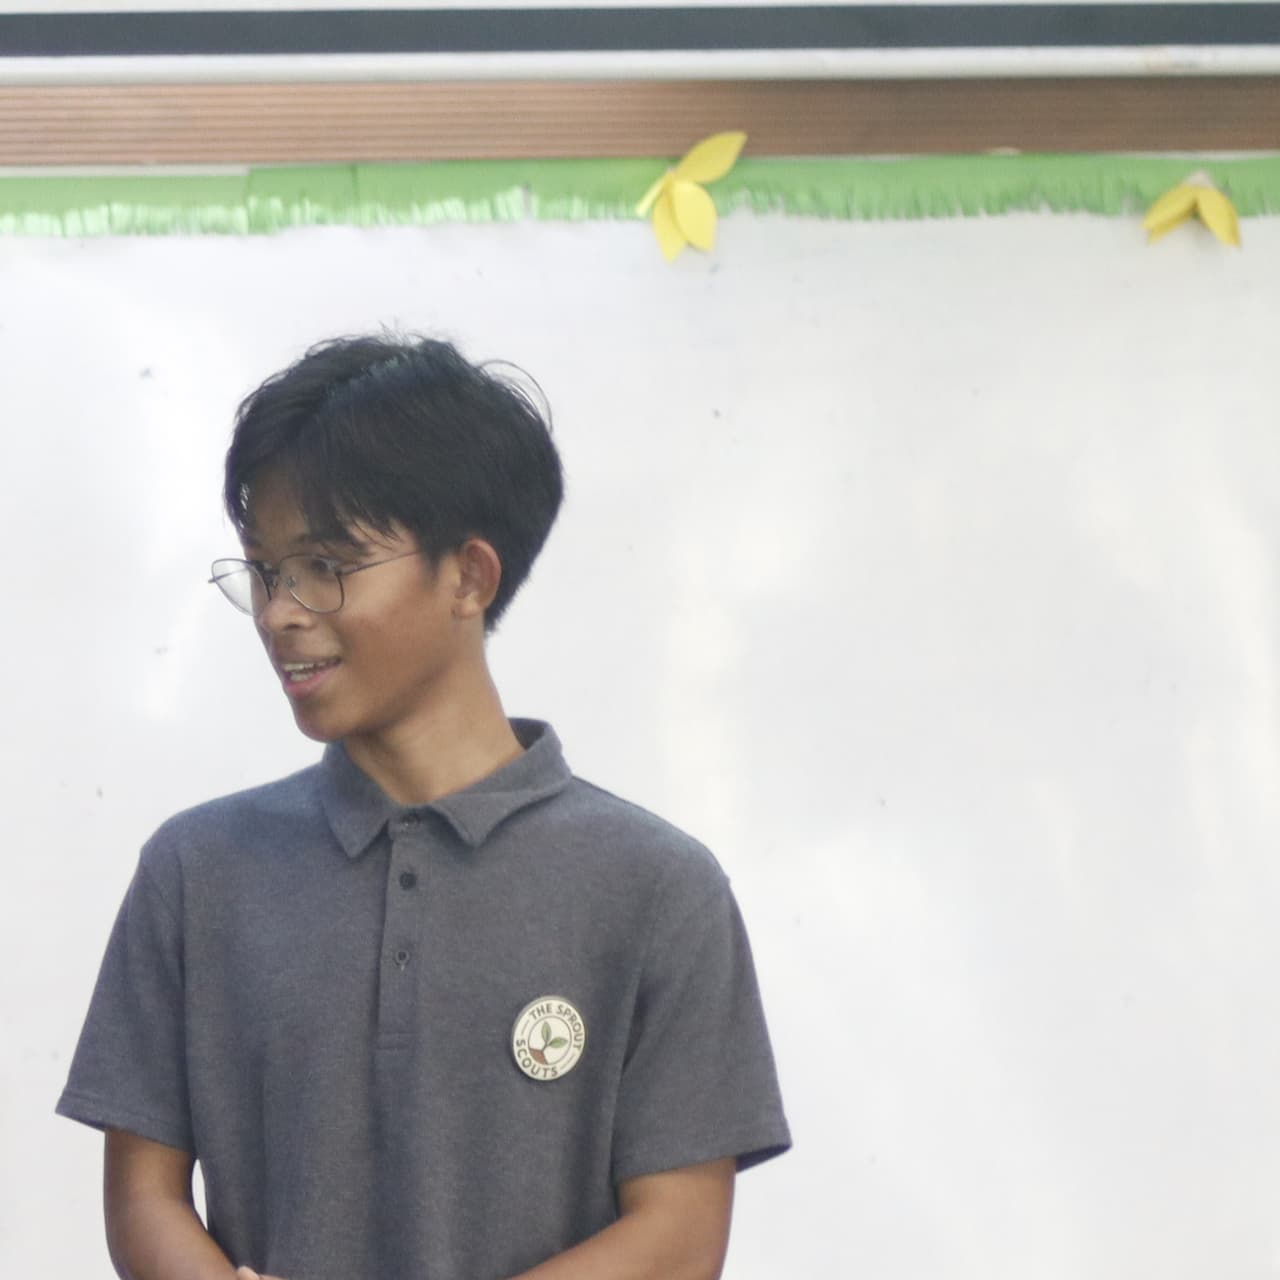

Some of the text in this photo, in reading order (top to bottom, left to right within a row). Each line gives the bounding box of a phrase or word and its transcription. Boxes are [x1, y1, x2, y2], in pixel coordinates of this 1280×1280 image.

[529, 1003, 584, 1052] THE SPROUT
[516, 1039, 558, 1078] SCOUTS
